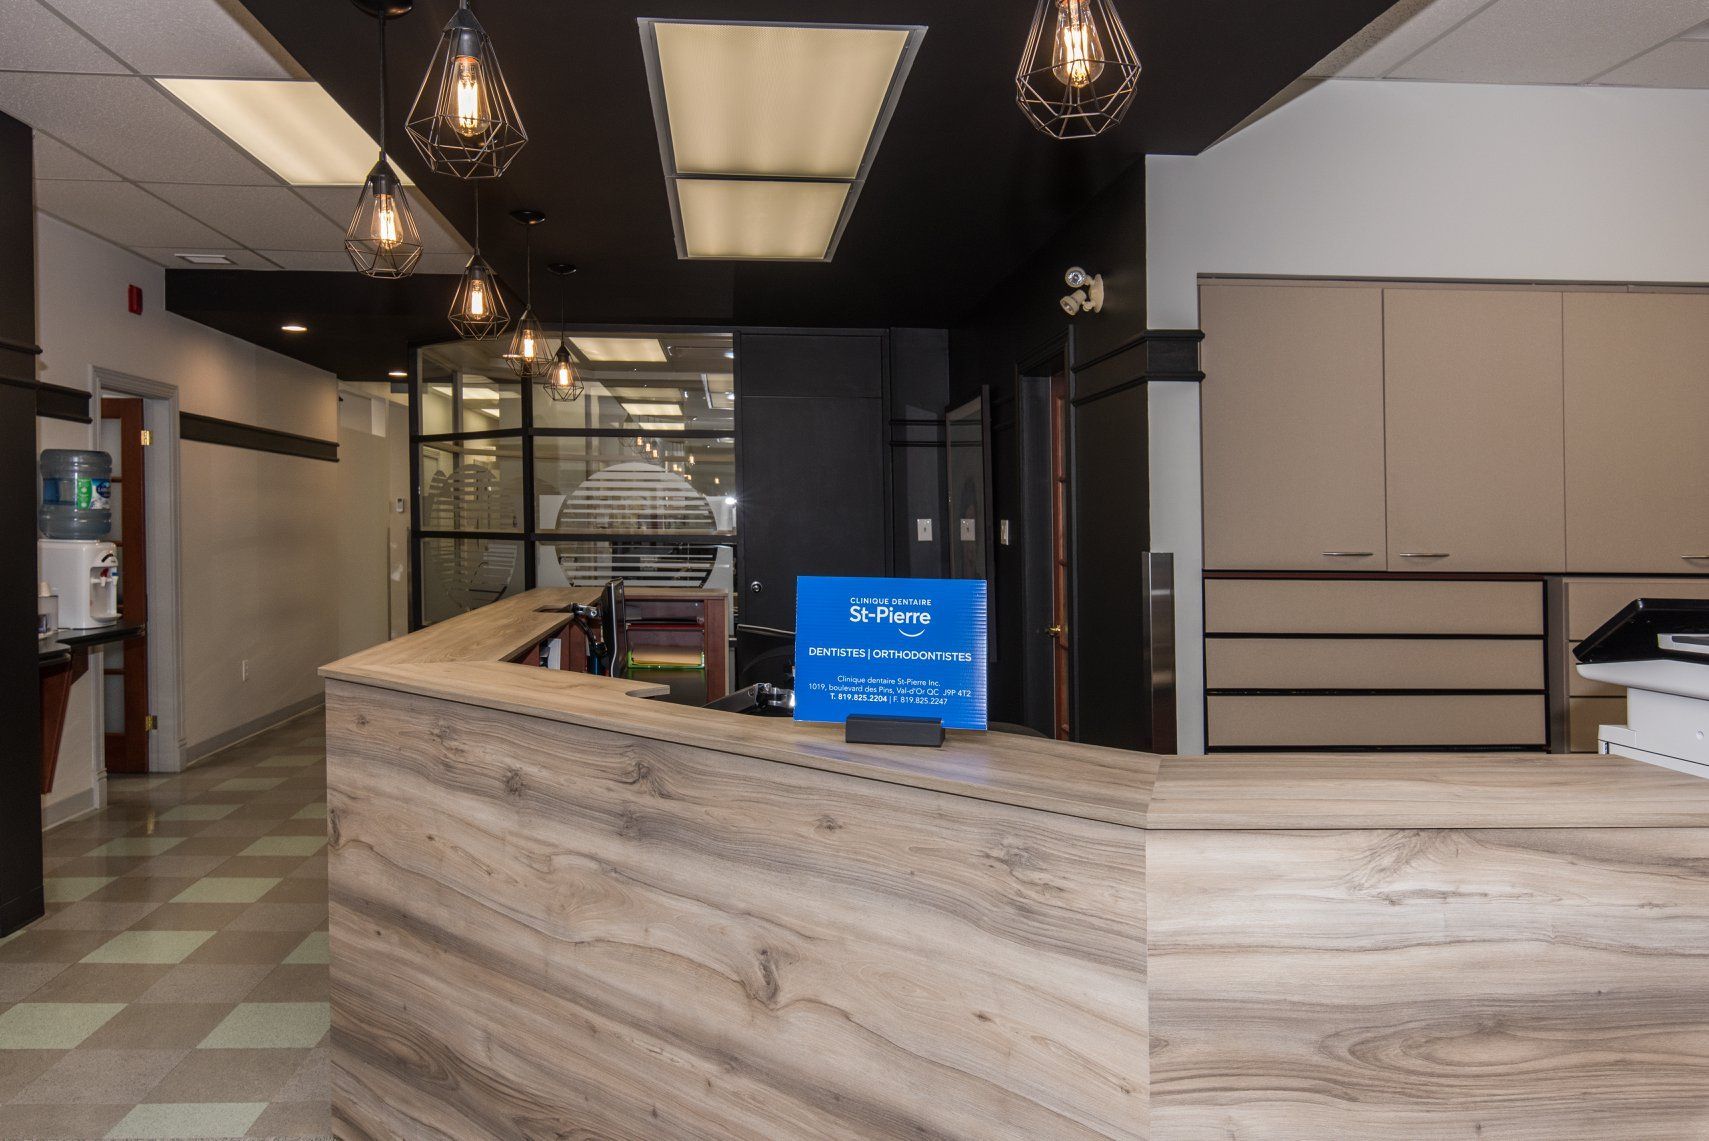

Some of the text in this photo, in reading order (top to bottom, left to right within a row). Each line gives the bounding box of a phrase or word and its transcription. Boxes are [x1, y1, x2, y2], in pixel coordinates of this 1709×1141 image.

[850, 597, 932, 606] CLINIQUE DENTAIRE
[849, 605, 931, 625] St-Pierre
[808, 646, 972, 662] DENTISTES ORTHODONTISTES
[837, 675, 941, 687] Clinique dentaire St-Pierre Inc.
[808, 682, 827, 692] 1019,
[828, 683, 863, 692] boulevard
[864, 685, 877, 693] des
[878, 686, 895, 694] Pins,
[926, 688, 940, 696] QC
[942, 689, 956, 697] J9P
[957, 690, 972, 698] 4T2
[830, 692, 948, 705] T. 819.825.2204 F. 819.825.2247
